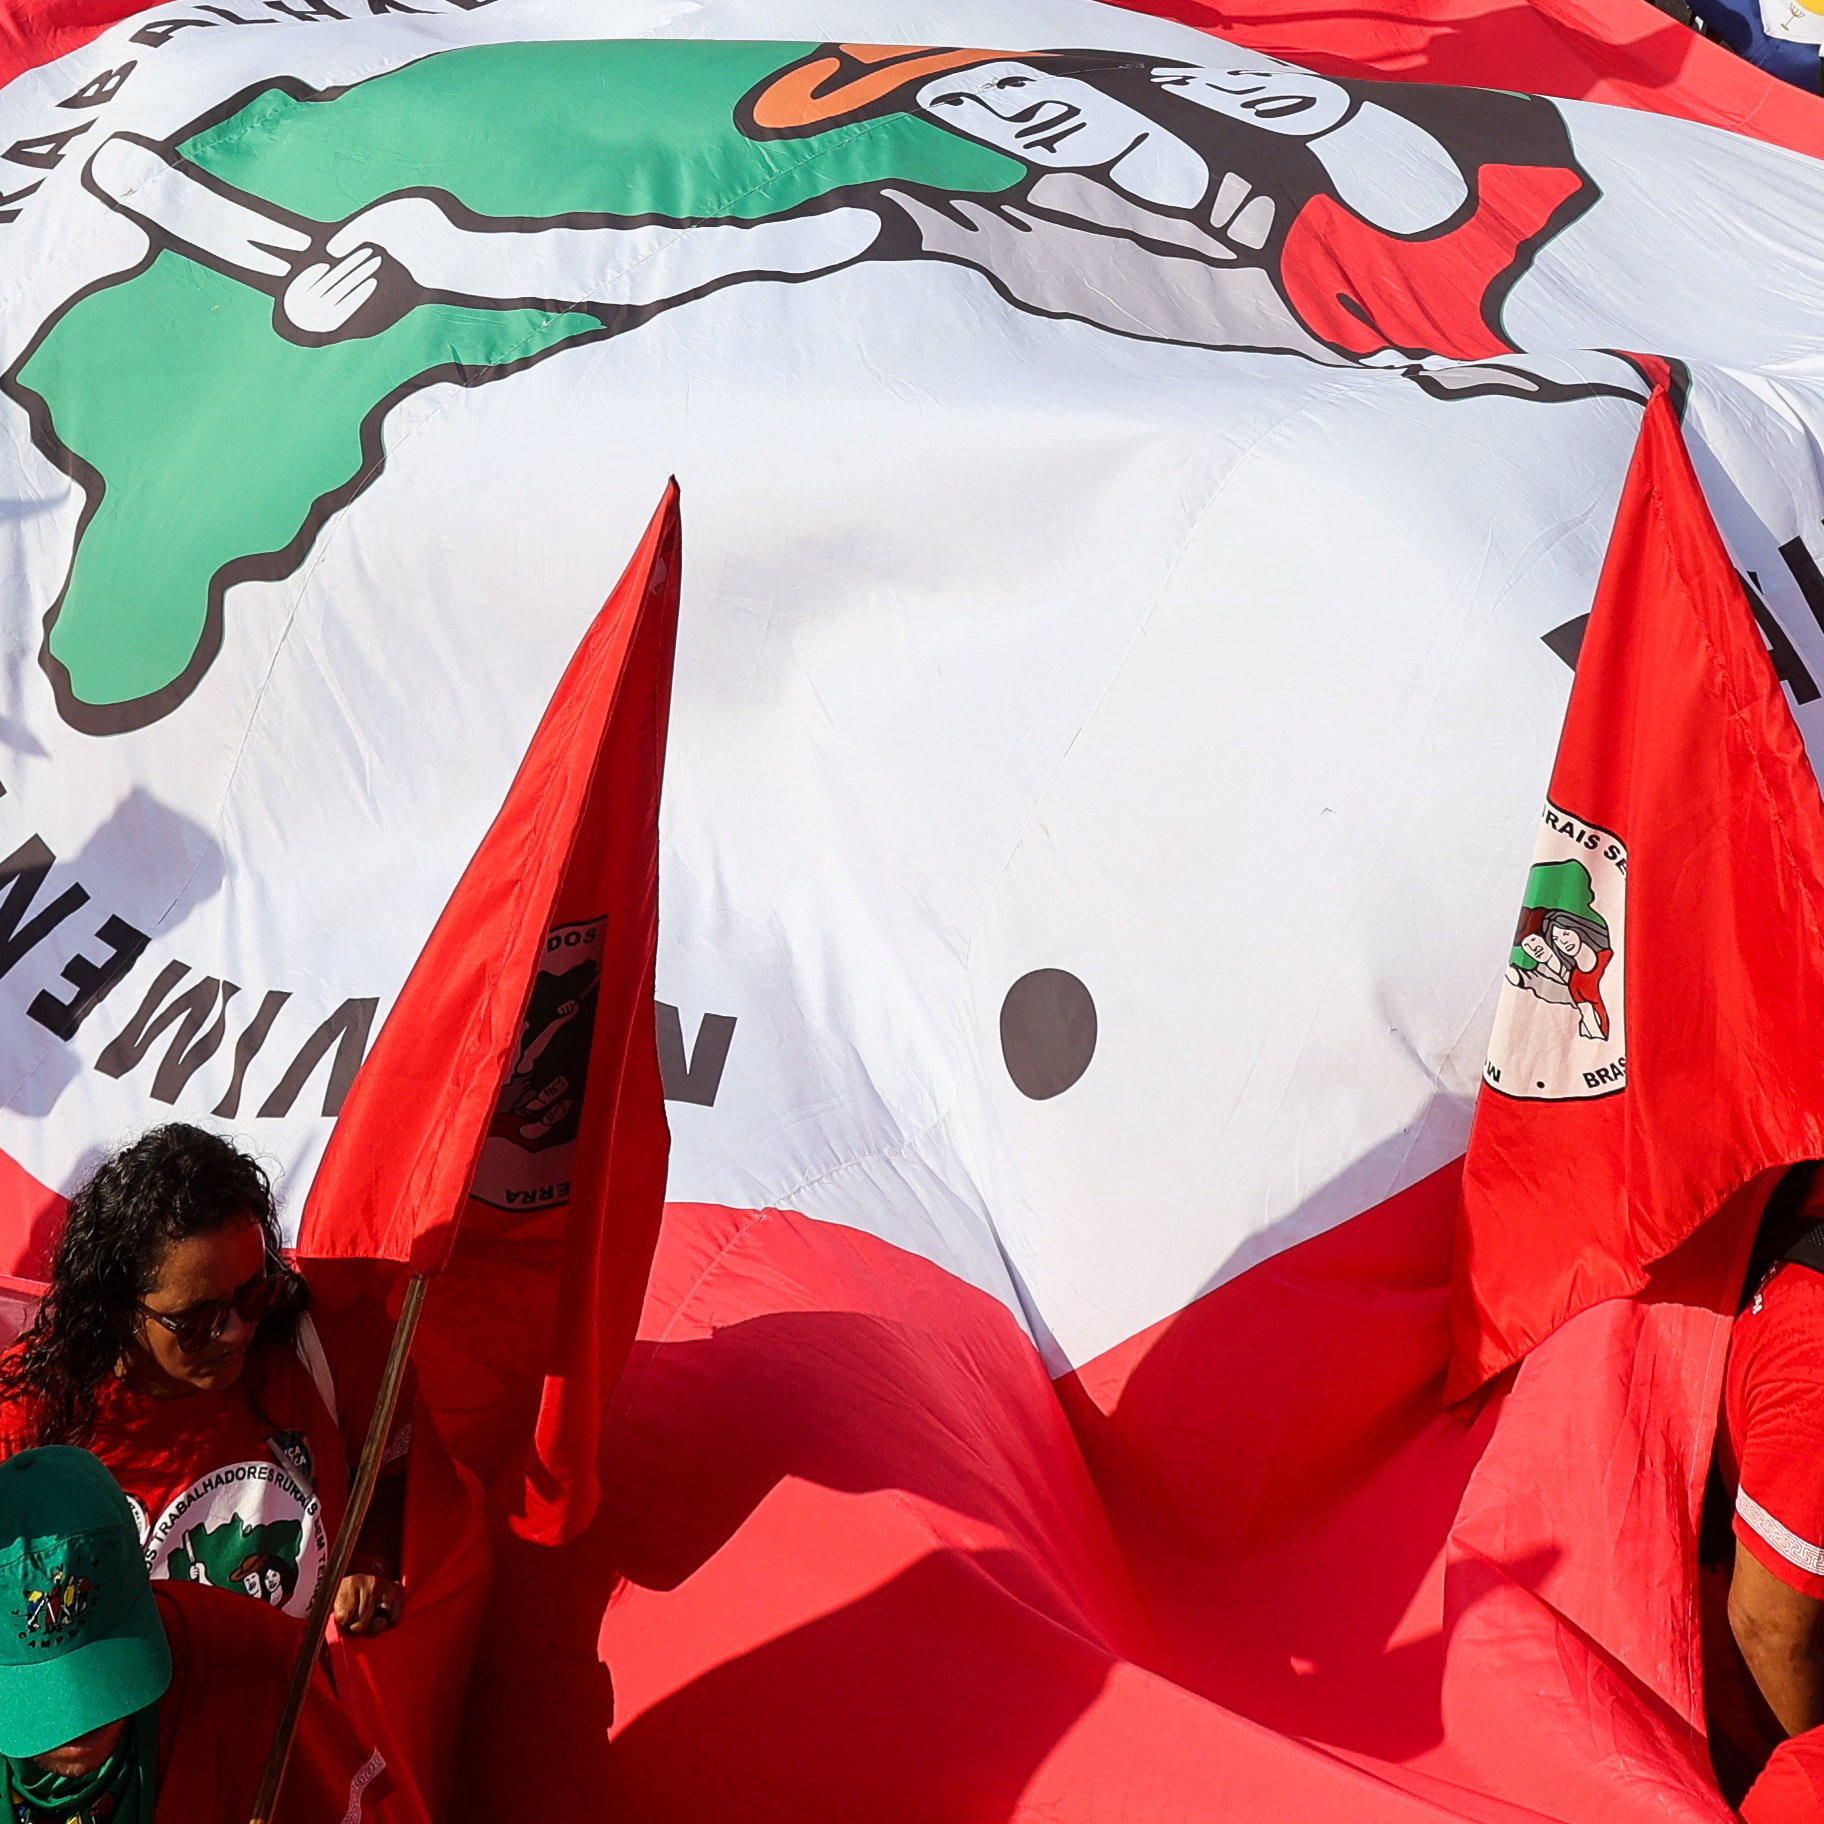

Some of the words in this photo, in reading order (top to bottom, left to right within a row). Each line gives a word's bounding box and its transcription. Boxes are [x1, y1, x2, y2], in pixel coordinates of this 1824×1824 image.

[546, 926, 598, 954] DOS
[504, 1179, 571, 1205] ERRA
[155, 1460, 276, 1549] TRABALHADORES
